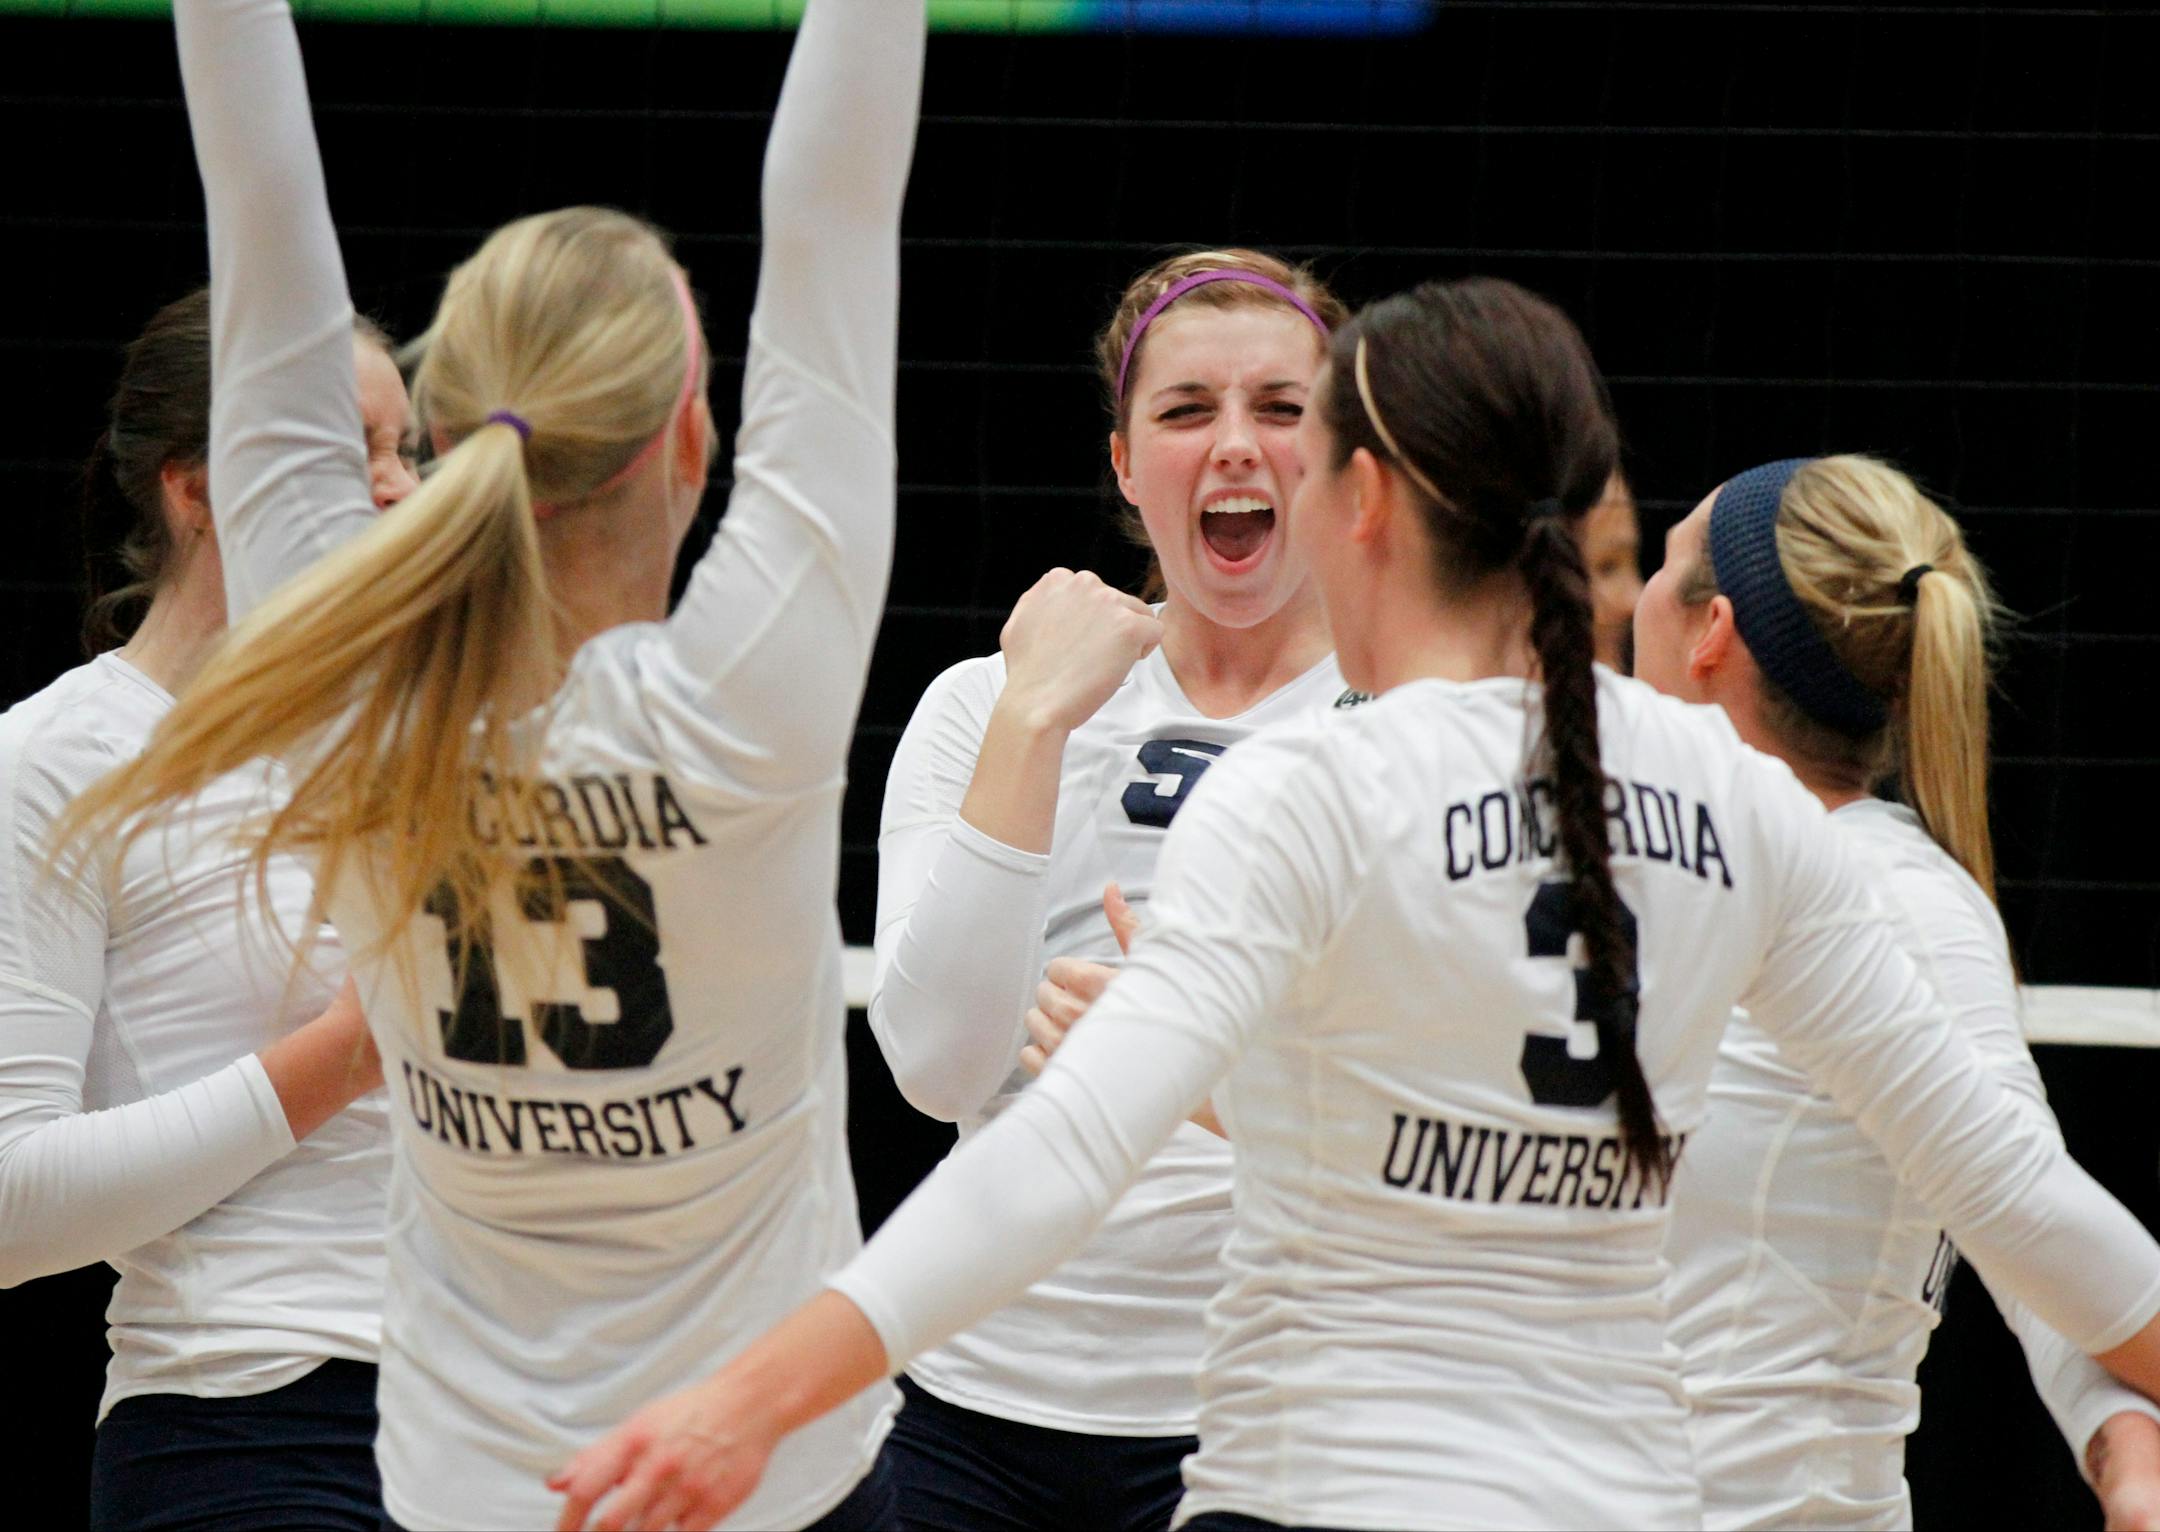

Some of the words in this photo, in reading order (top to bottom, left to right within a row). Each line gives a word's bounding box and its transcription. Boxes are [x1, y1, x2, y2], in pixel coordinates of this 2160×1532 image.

[422, 855, 674, 1070] 13
[1521, 878, 1640, 1108] 3
[402, 1062, 747, 1160] UNIVERSITY
